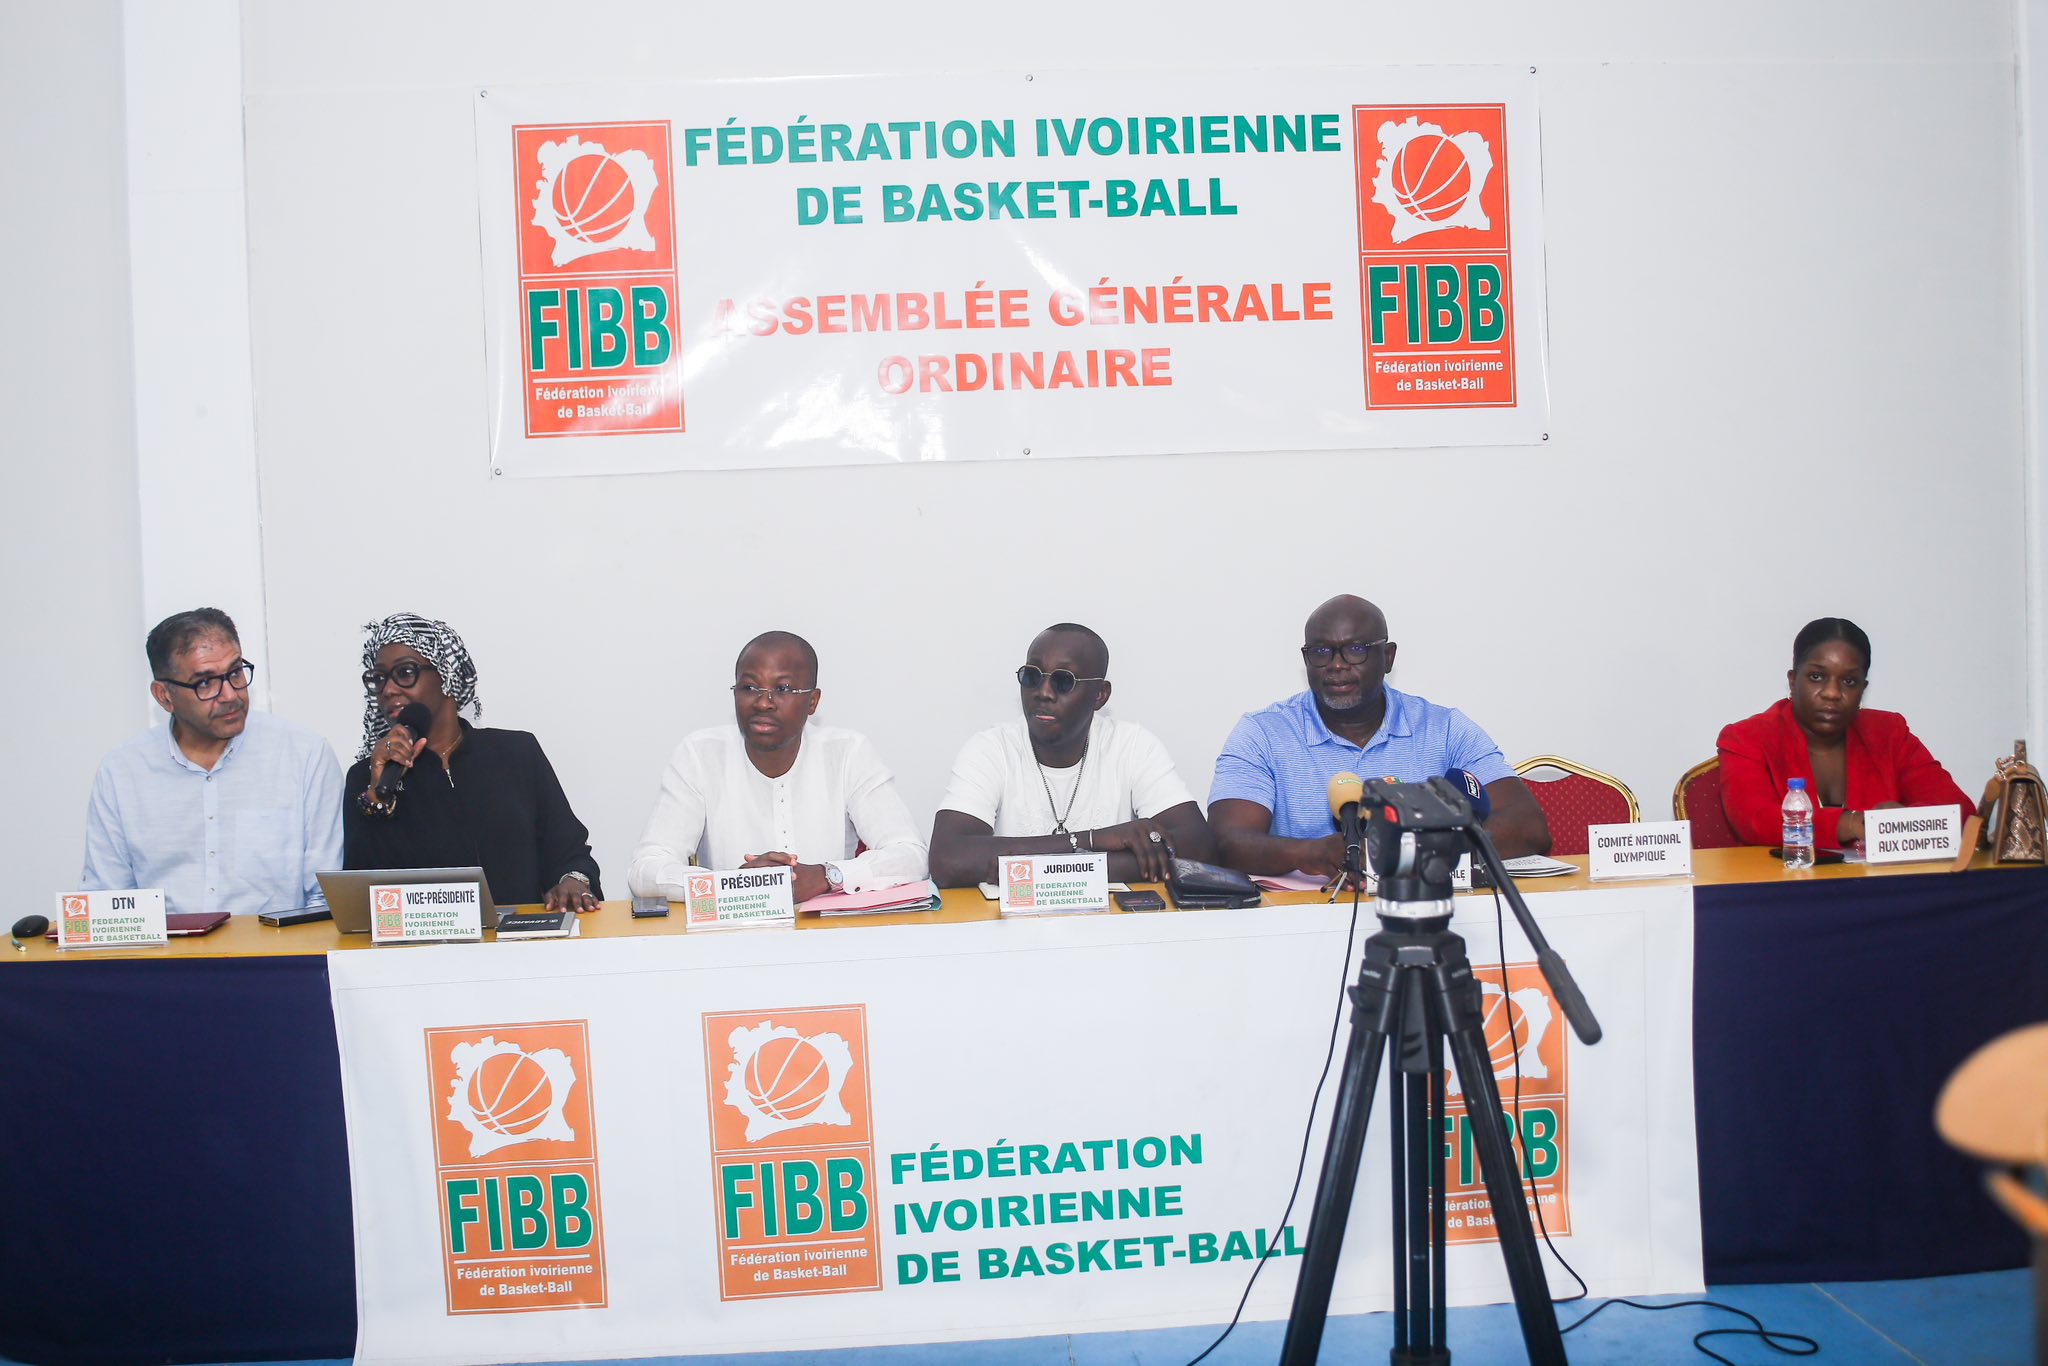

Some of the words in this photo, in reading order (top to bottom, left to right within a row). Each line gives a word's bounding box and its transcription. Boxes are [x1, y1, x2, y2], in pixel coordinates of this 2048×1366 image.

[684, 115, 1016, 167] FÉDÉRATION
[1036, 114, 1342, 158] IVOIRIENNE
[796, 186, 864, 226] DE
[882, 178, 1238, 223] BASKET-BALL
[711, 281, 1030, 338] ASSEMBLÉE
[1048, 276, 1333, 326] GÉNÉRALE
[1367, 263, 1506, 346] FIBB
[528, 284, 672, 372] FIBB
[877, 347, 1173, 395] ORDINAIRE
[1375, 360, 1441, 373] Fédération
[1444, 358, 1504, 372] ivoirienne
[1396, 379, 1411, 391] de
[1415, 377, 1484, 391] Basket-Ball
[535, 385, 604, 401] Fédération
[557, 406, 574, 419] de
[1878, 818, 1948, 834] COMMISSAIRE
[1597, 834, 1633, 848] COMITÉ
[1635, 833, 1681, 846] NATIONAL
[1878, 840, 1899, 853] AUX
[1901, 836, 1949, 851] COMPTES
[1613, 850, 1666, 863] OLYMPIQUE
[1043, 862, 1095, 874] JURIDIQUE
[720, 873, 785, 890] PRÉSIDENT
[1035, 881, 1088, 889] FEDERATION
[718, 894, 770, 903] FEDERATION
[1036, 889, 1084, 897] IVOIRIENNE
[112, 897, 135, 910] DTN
[718, 902, 767, 912] IVOIRIENNE
[91, 917, 145, 925] FEDERATION
[404, 911, 459, 919] FEDERATION
[405, 920, 455, 928] IVOIRIENNE
[890, 1133, 1203, 1185] FÉDÉRATION
[721, 1157, 868, 1240] FIBB
[446, 1172, 593, 1254] FIBB
[894, 1185, 1183, 1235] IVOIRIENNE
[1447, 1216, 1463, 1228] de
[730, 1250, 801, 1266] Fédération
[804, 1246, 868, 1262] ivoirienne
[898, 1251, 961, 1286] DE
[978, 1226, 1306, 1281] BASKET-BALL
[457, 1264, 527, 1279] Fédération
[530, 1262, 593, 1277] ivoirienne
[753, 1268, 770, 1282] de
[773, 1263, 847, 1280] Basket-Ball
[479, 1283, 495, 1296] de
[499, 1279, 573, 1295] Basket-Ball
